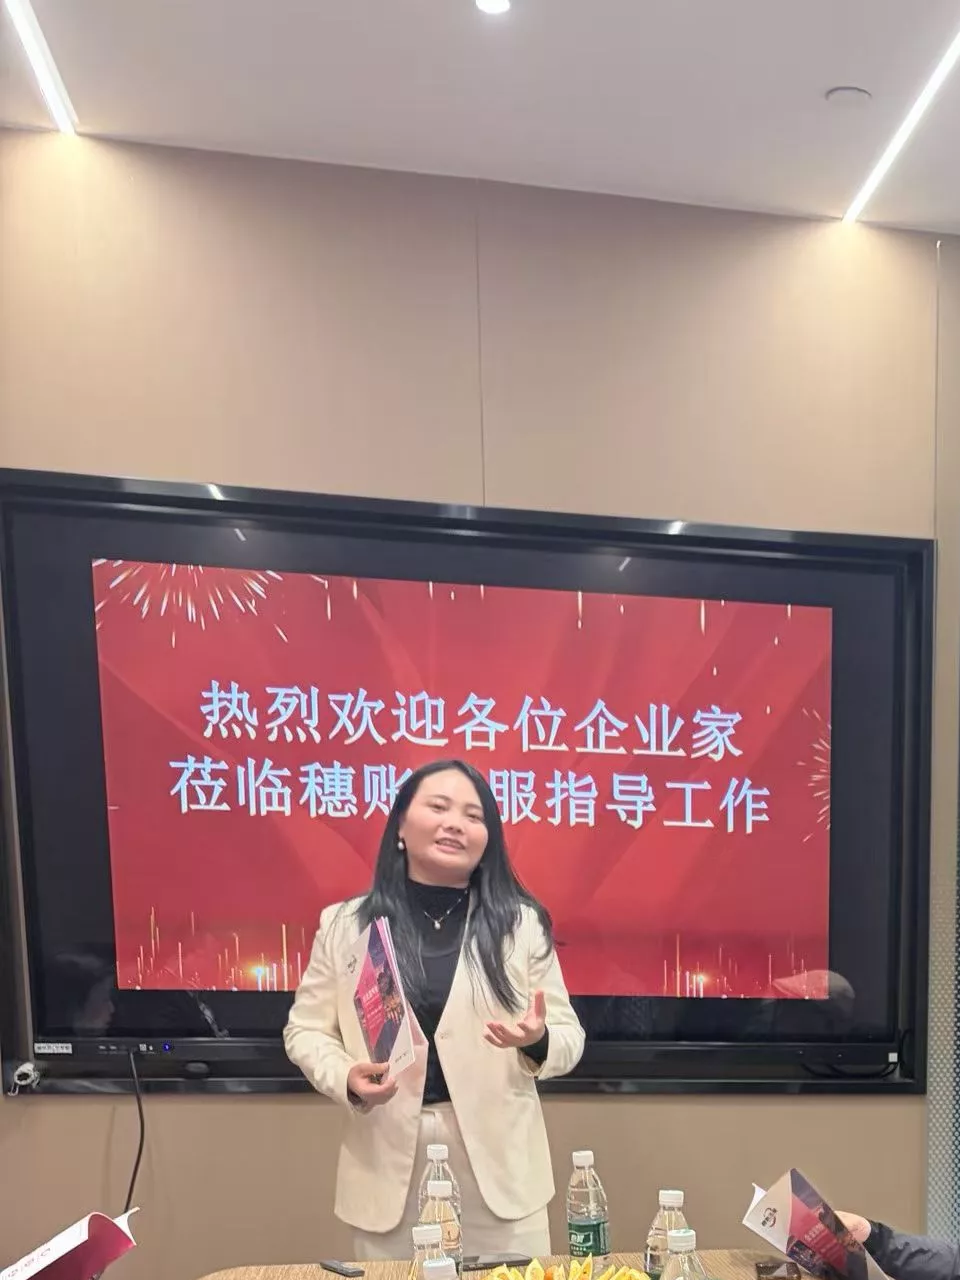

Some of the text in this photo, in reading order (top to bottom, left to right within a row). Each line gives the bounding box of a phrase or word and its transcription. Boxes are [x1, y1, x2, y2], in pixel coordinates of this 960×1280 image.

[200, 679, 744, 763] 热烈欢迎各位企业家
[168, 755, 772, 835] 莅临穗账服指导工作
